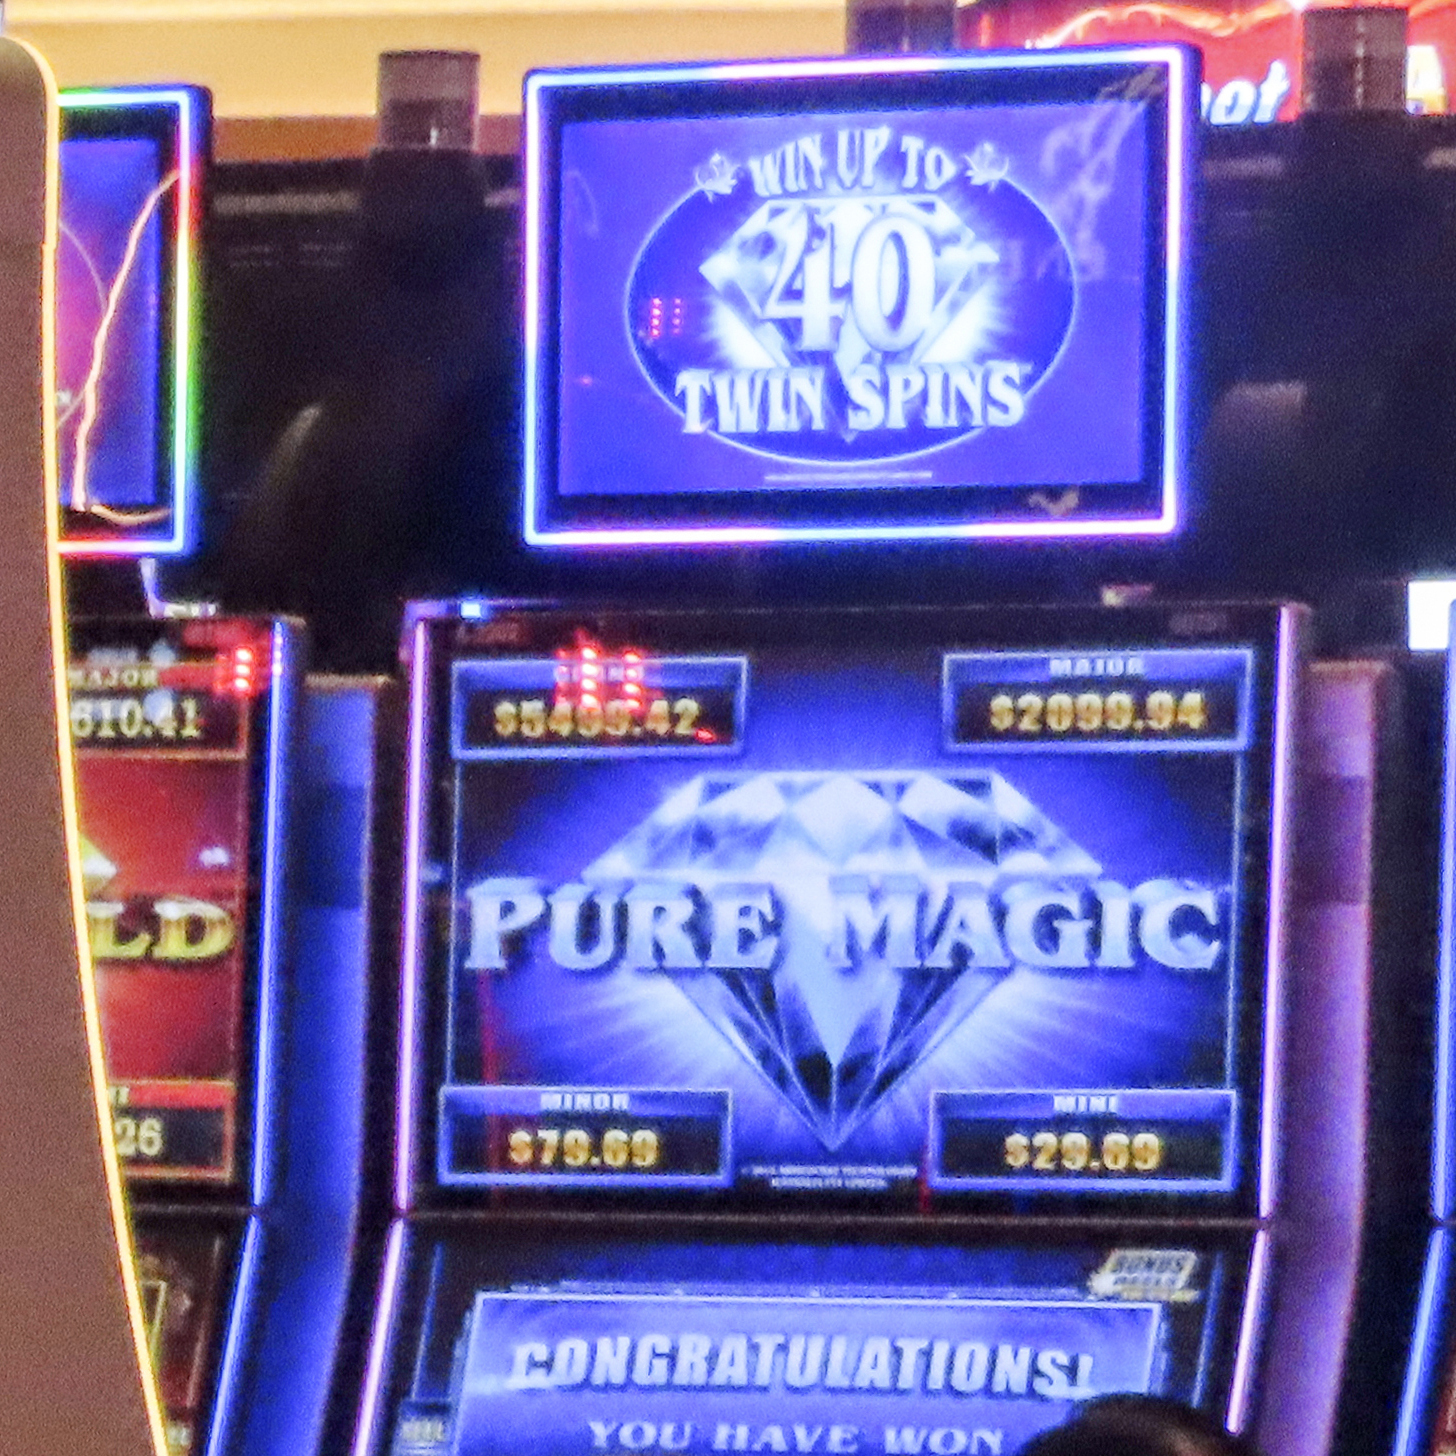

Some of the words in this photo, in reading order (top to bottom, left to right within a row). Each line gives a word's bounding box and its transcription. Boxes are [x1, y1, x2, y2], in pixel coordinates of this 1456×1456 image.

[747, 132, 826, 197] WIN
[837, 123, 891, 189] UP
[900, 134, 957, 191] TO
[760, 205, 939, 352] 40
[674, 365, 827, 434] TWIN
[845, 360, 1031, 431] SPINS
[69, 697, 202, 739] 610.41
[87, 894, 236, 960] LD
[463, 876, 781, 972] PURE
[829, 876, 1227, 972] MAGIC
[510, 1331, 1095, 1399] CONGRATULATIONS!
[588, 1419, 691, 1451] YOU
[711, 1421, 859, 1454] HAVE
